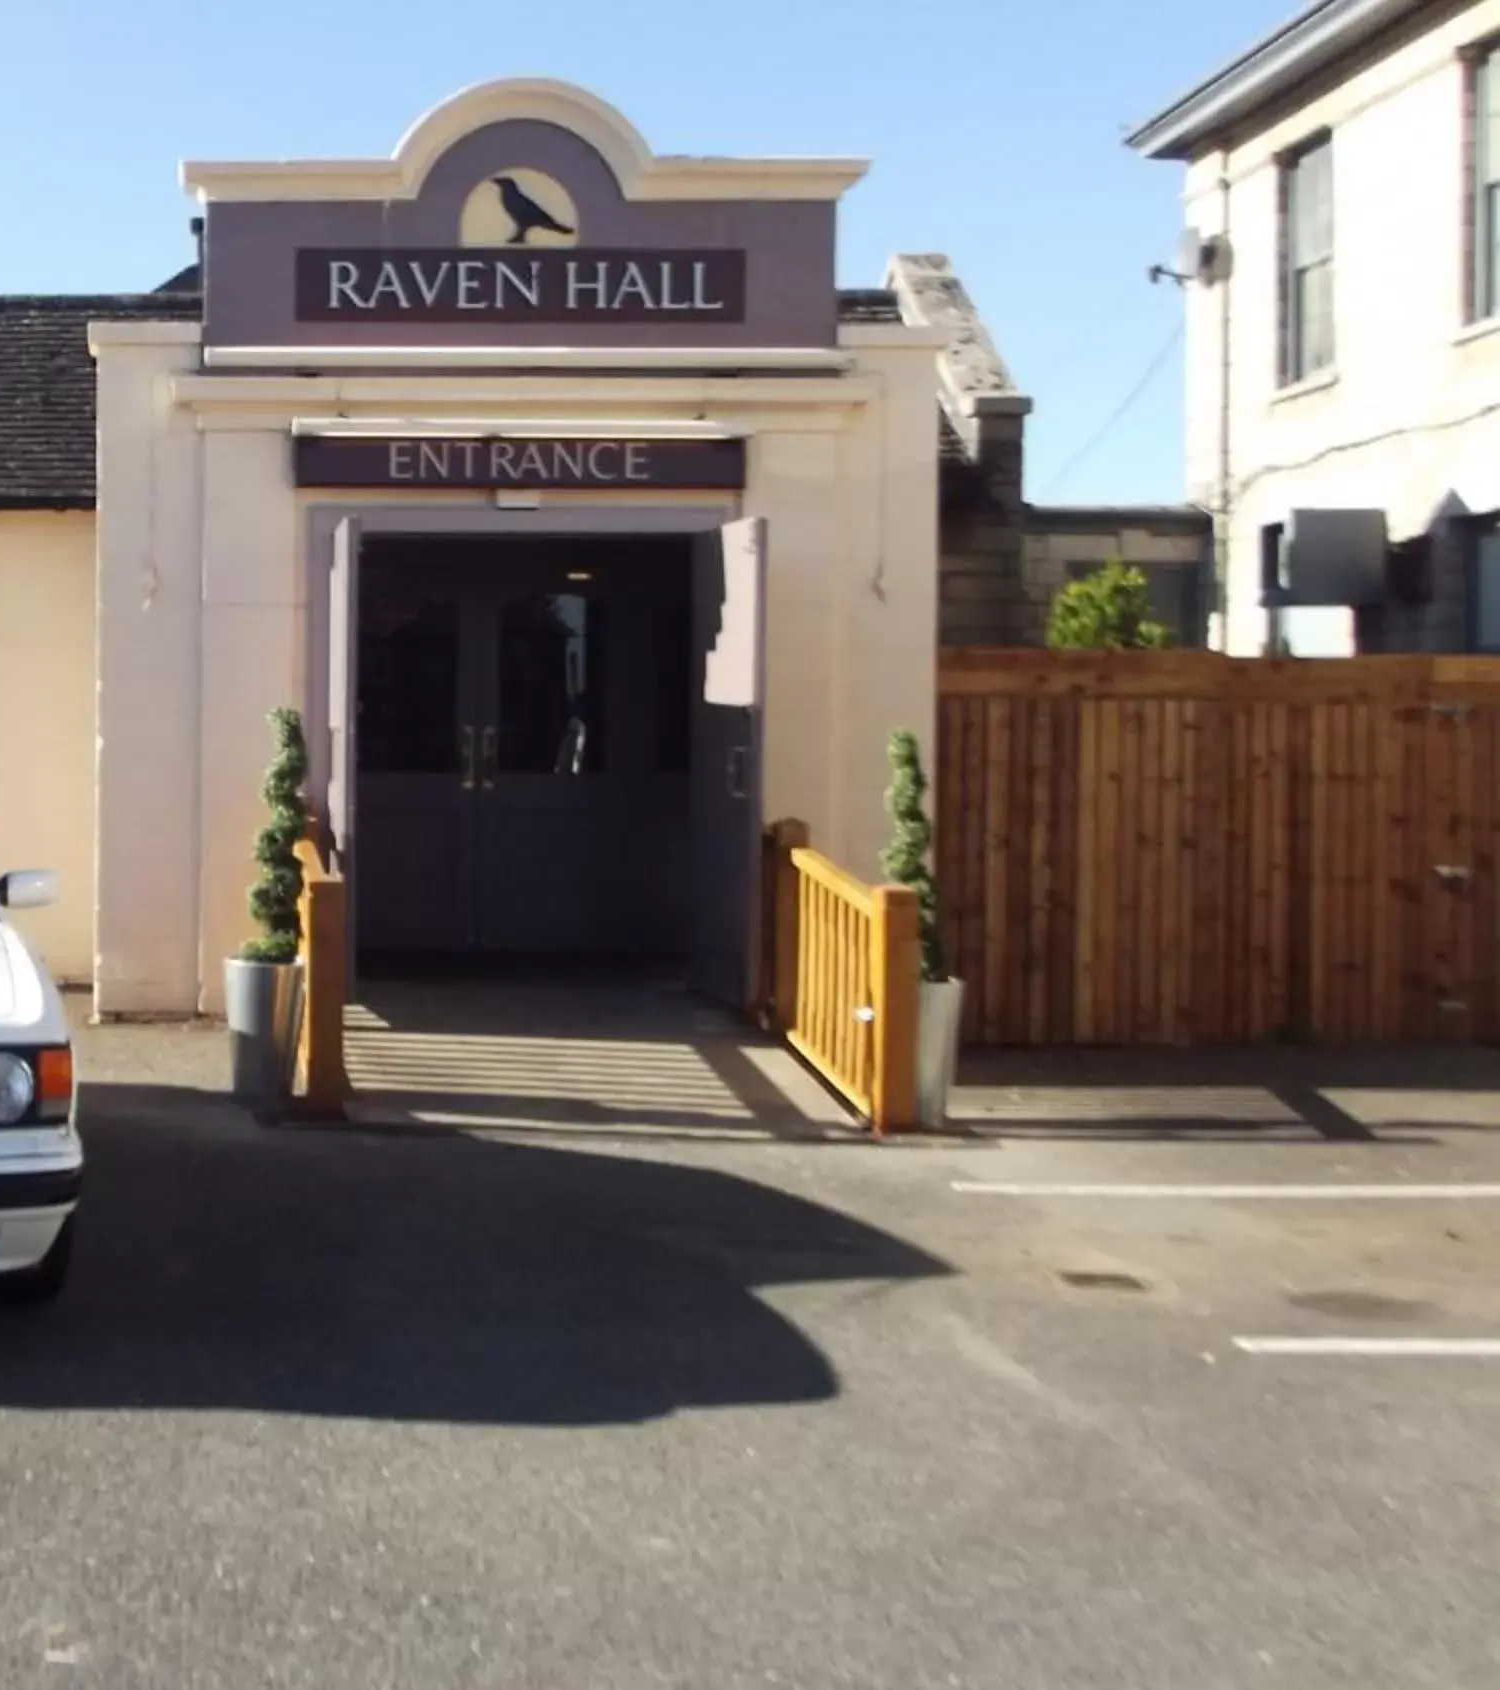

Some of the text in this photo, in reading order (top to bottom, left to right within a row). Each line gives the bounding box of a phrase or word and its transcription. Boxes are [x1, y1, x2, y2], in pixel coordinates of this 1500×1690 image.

[328, 261, 723, 309] RAVEN HALL
[388, 441, 651, 480] ENTRANCE
